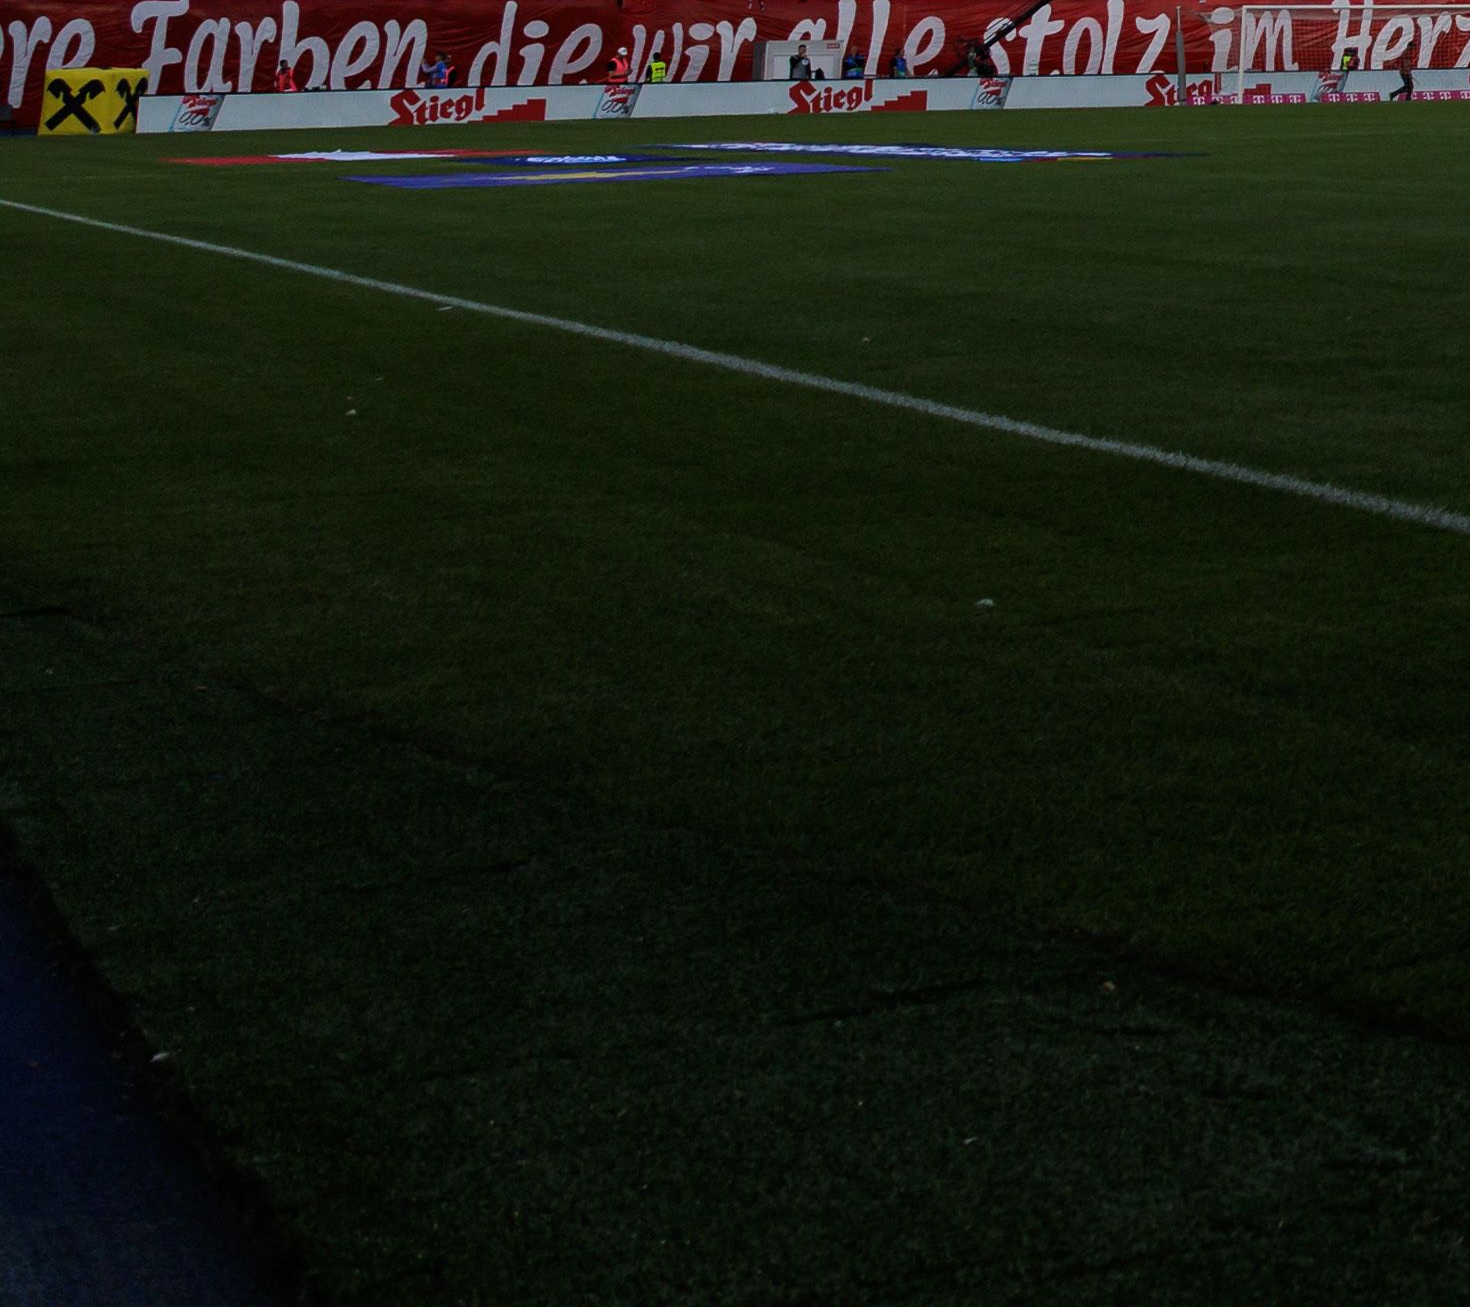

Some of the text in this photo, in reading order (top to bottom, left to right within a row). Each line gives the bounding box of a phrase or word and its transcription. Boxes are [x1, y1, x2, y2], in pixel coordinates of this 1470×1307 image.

[467, 0, 604, 87] die
[1207, 6, 1300, 73] im
[388, 87, 486, 128] Stiegl
[787, 78, 873, 115] Stiegl
